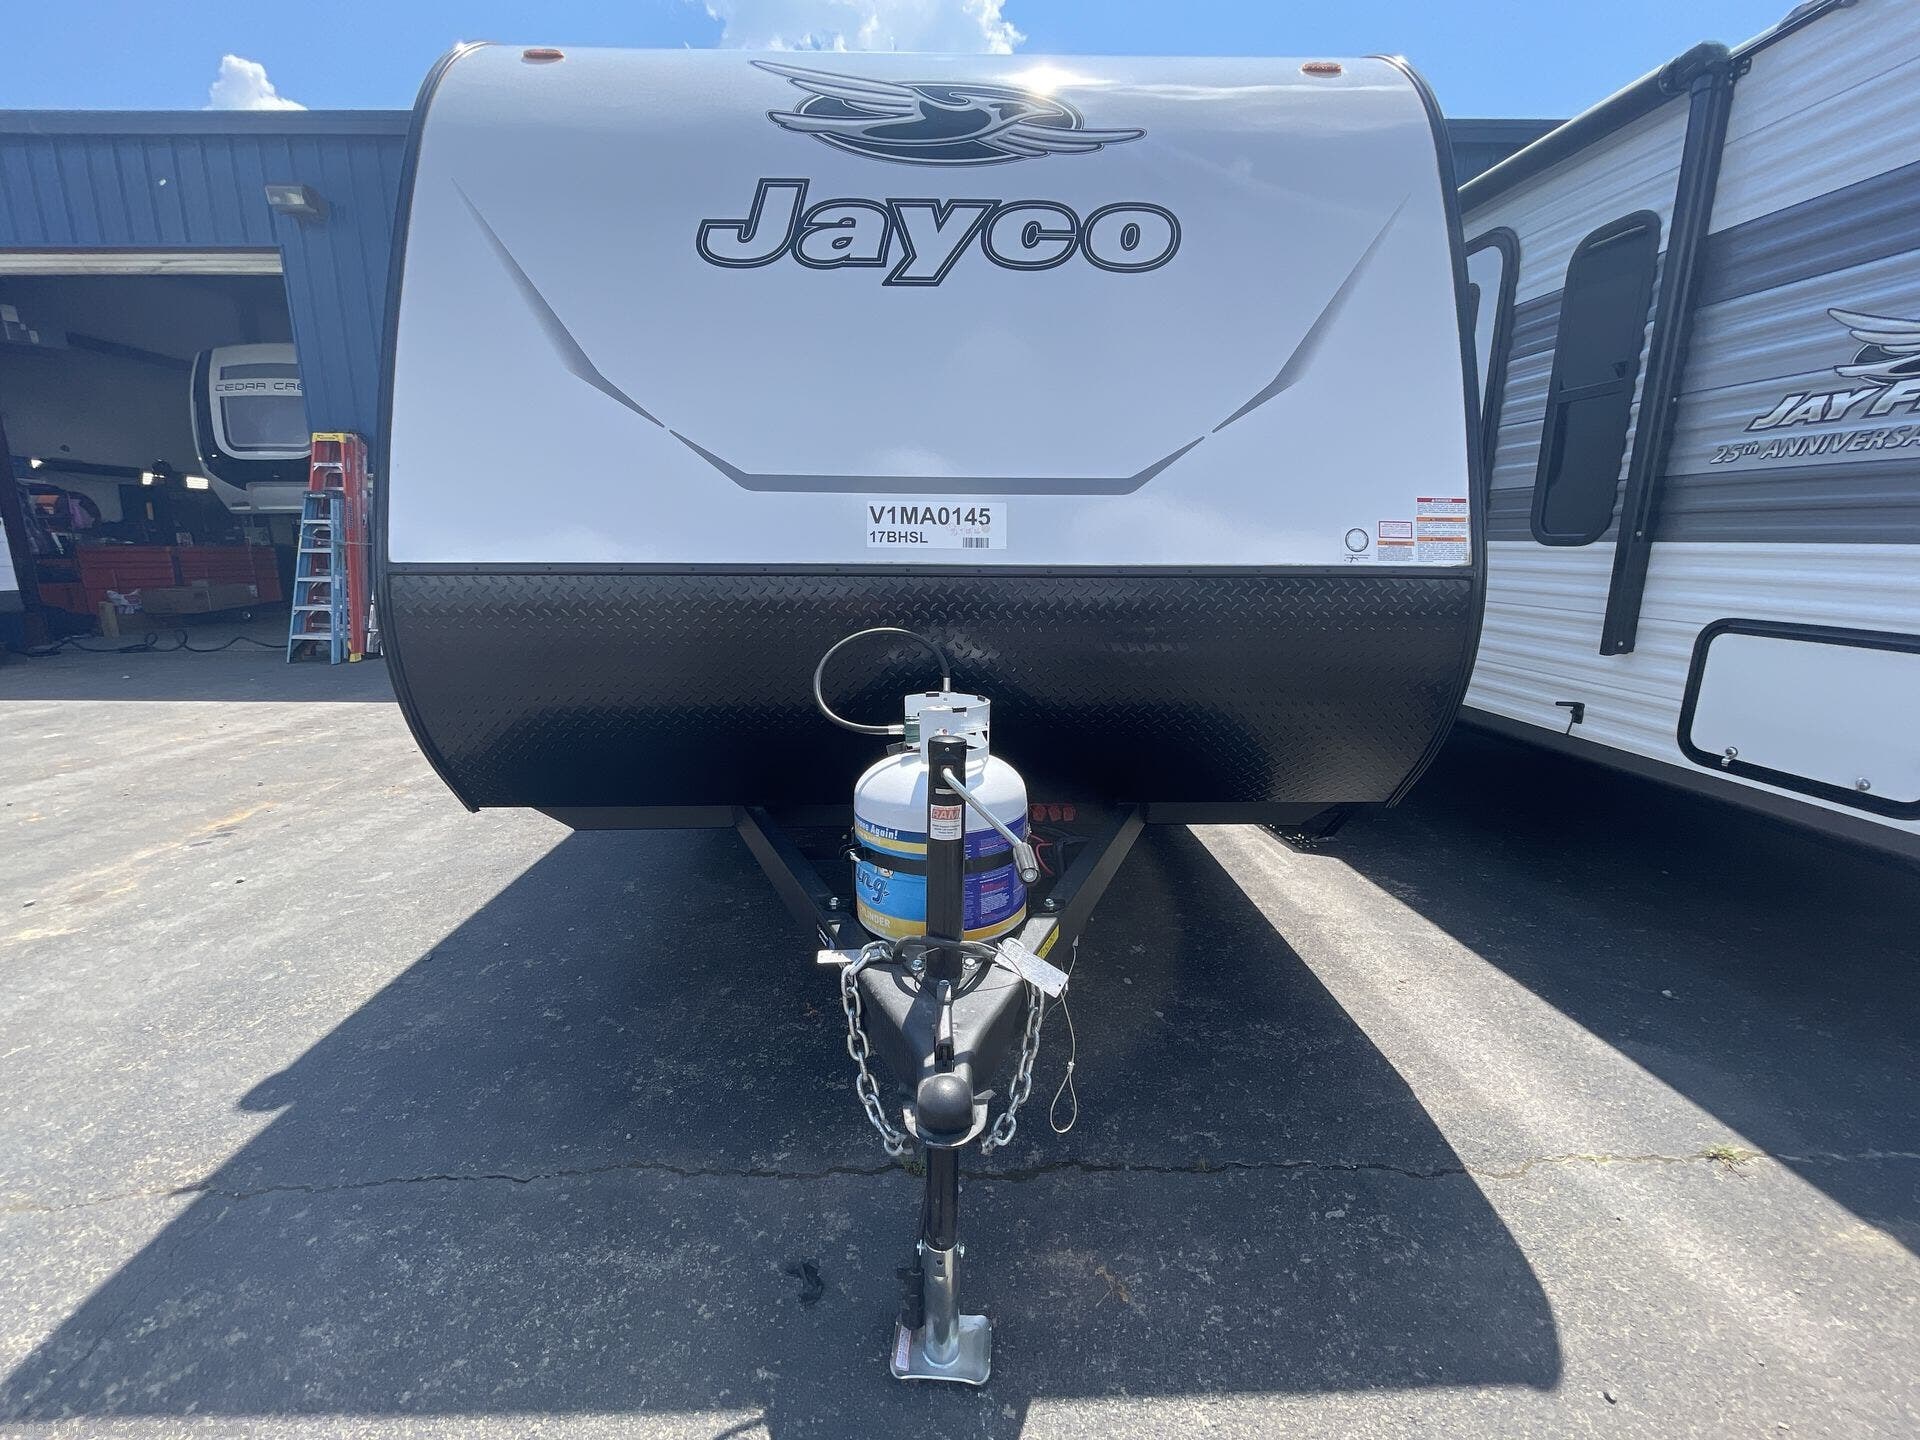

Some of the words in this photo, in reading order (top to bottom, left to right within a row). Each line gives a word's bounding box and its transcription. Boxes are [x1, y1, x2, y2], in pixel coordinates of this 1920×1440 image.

[695, 177, 1182, 287] Jayco
[215, 382, 266, 392] CEDAR
[1744, 386, 1885, 432] JAY
[1862, 377, 1920, 418] F
[1710, 441, 1759, 465] 25th
[869, 505, 991, 526] V1MA0145
[869, 531, 929, 544] 17BHSL
[870, 824, 899, 840] Again!
